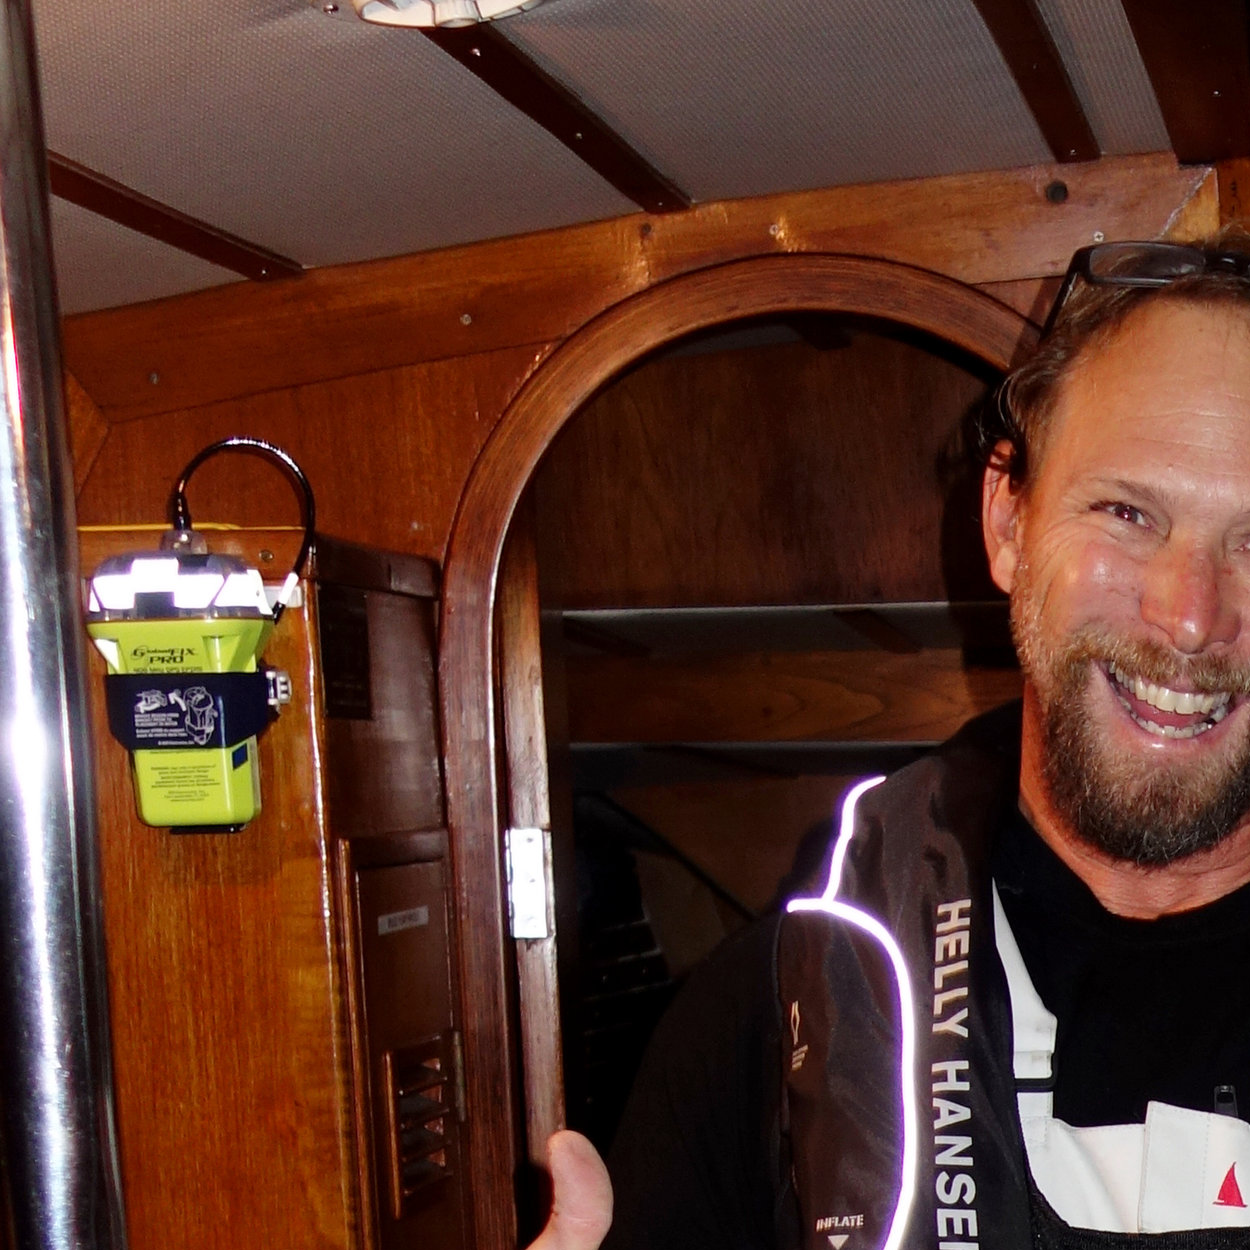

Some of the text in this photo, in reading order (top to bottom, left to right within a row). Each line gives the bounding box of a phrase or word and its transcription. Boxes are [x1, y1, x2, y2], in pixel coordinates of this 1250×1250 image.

[149, 655, 184, 664] PRO
[933, 898, 972, 1039] HELLY
[816, 1214, 864, 1232] INFLATE
